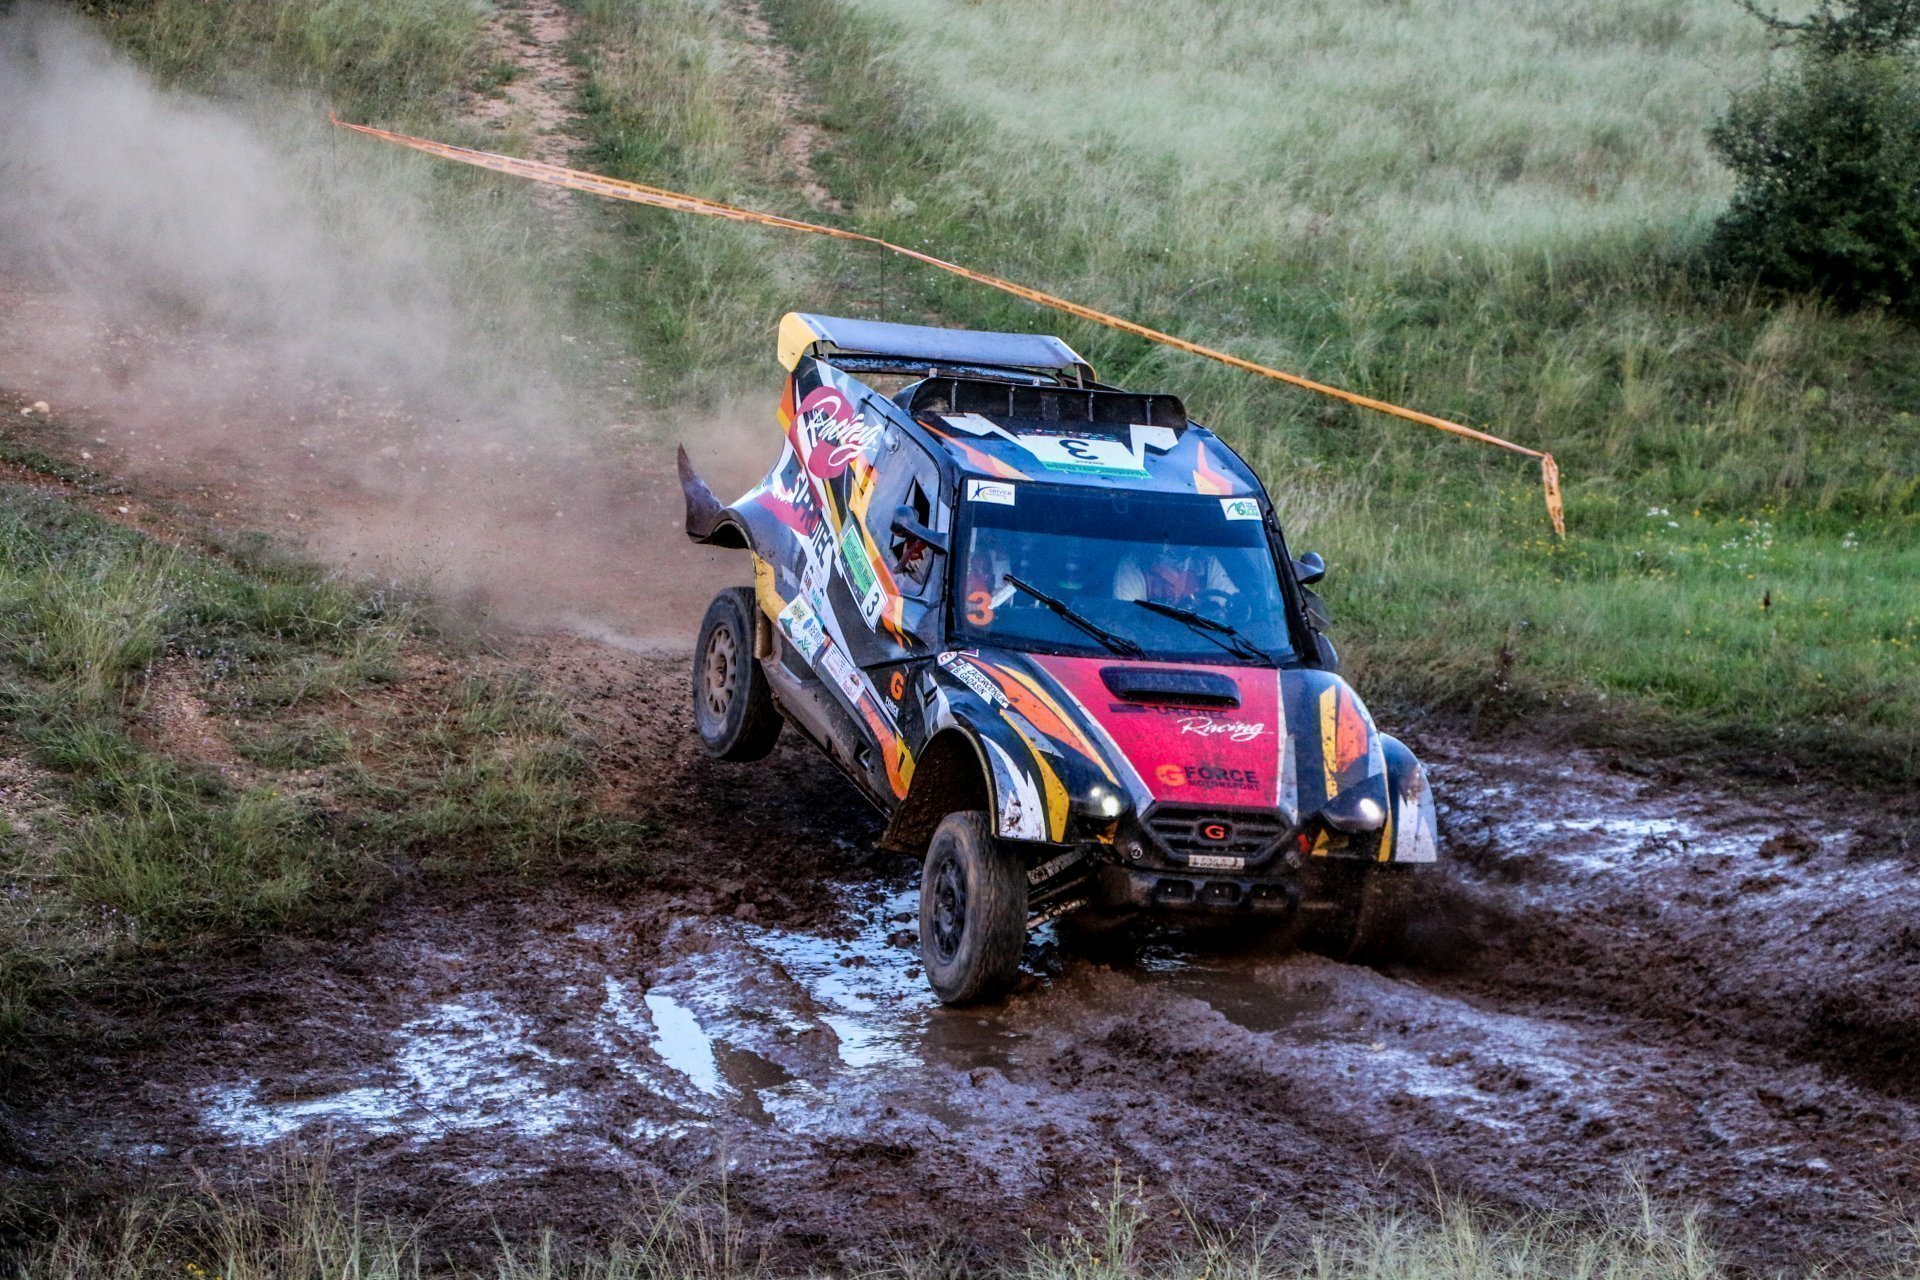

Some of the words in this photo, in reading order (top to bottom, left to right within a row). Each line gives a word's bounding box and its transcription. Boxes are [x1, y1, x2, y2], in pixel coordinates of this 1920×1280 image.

[806, 395, 882, 467] Racing
[1059, 439, 1098, 460] 3
[866, 592, 880, 617] 3
[967, 591, 994, 625] 3
[890, 671, 905, 700] G
[960, 673, 986, 695] GADASIN
[1177, 716, 1274, 742] Racing
[1205, 825, 1225, 839] G
